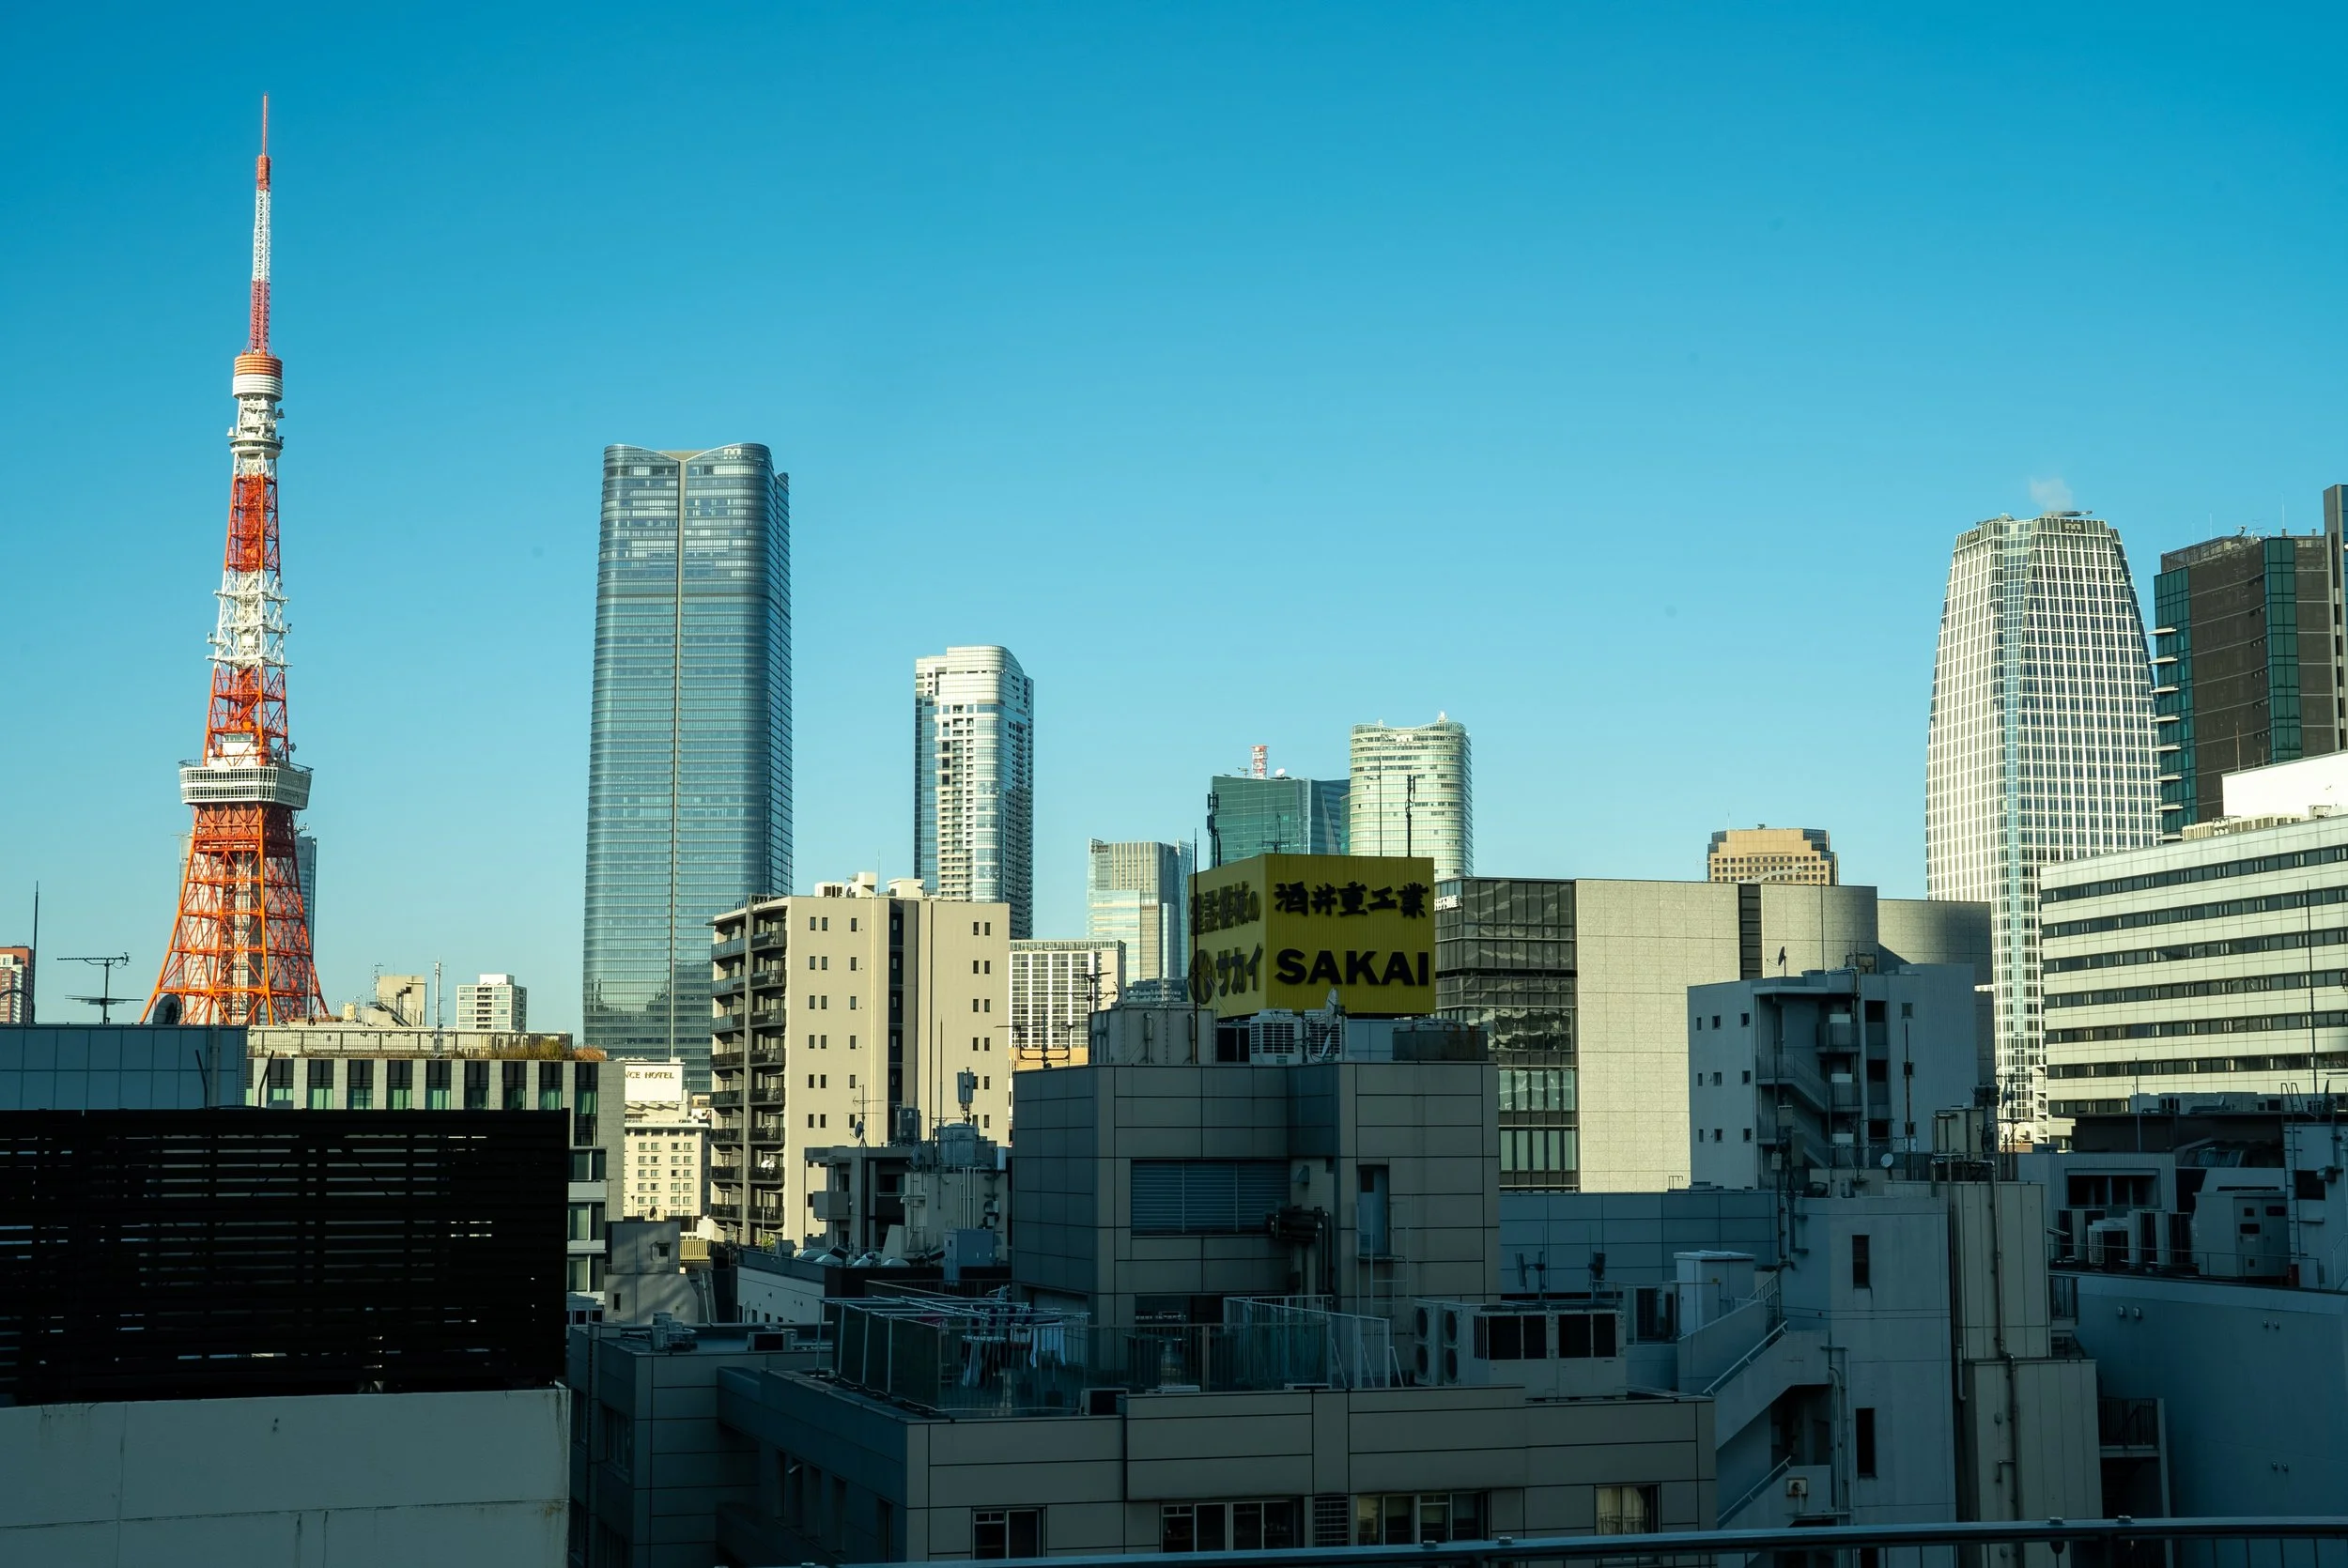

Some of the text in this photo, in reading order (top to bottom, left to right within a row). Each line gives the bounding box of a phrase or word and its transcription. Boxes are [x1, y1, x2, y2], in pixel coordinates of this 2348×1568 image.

[1274, 881, 1429, 919] 酒井重工業
[1216, 943, 1263, 997] サカイ
[1274, 948, 1429, 986] SAKAI
